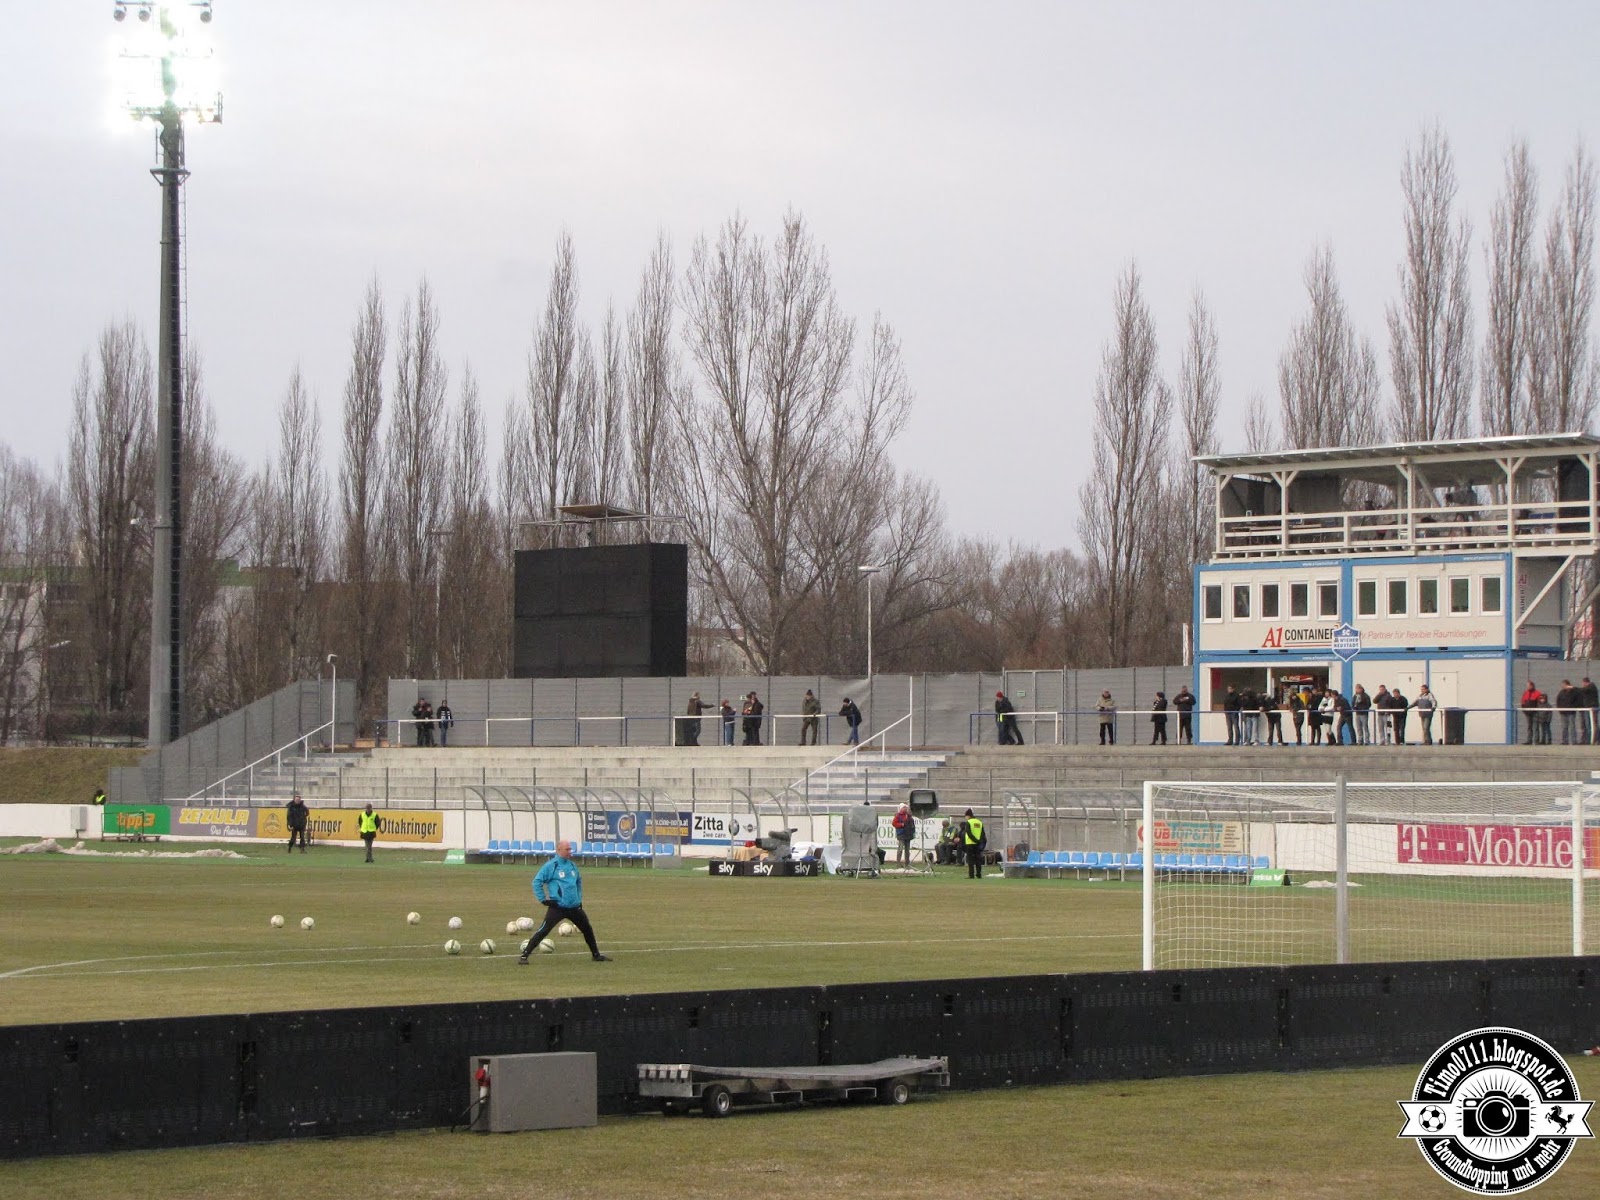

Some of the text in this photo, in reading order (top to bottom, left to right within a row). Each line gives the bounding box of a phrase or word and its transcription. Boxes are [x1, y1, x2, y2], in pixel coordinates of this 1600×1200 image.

[1261, 627, 1283, 648] A1
[116, 812, 156, 829] tipp3
[178, 808, 250, 825] ZEZULA
[694, 815, 724, 831] Zitta
[379, 817, 438, 839] Ottakringer
[718, 861, 735, 876] sky
[753, 861, 774, 876] sky
[794, 861, 811, 876] sky
